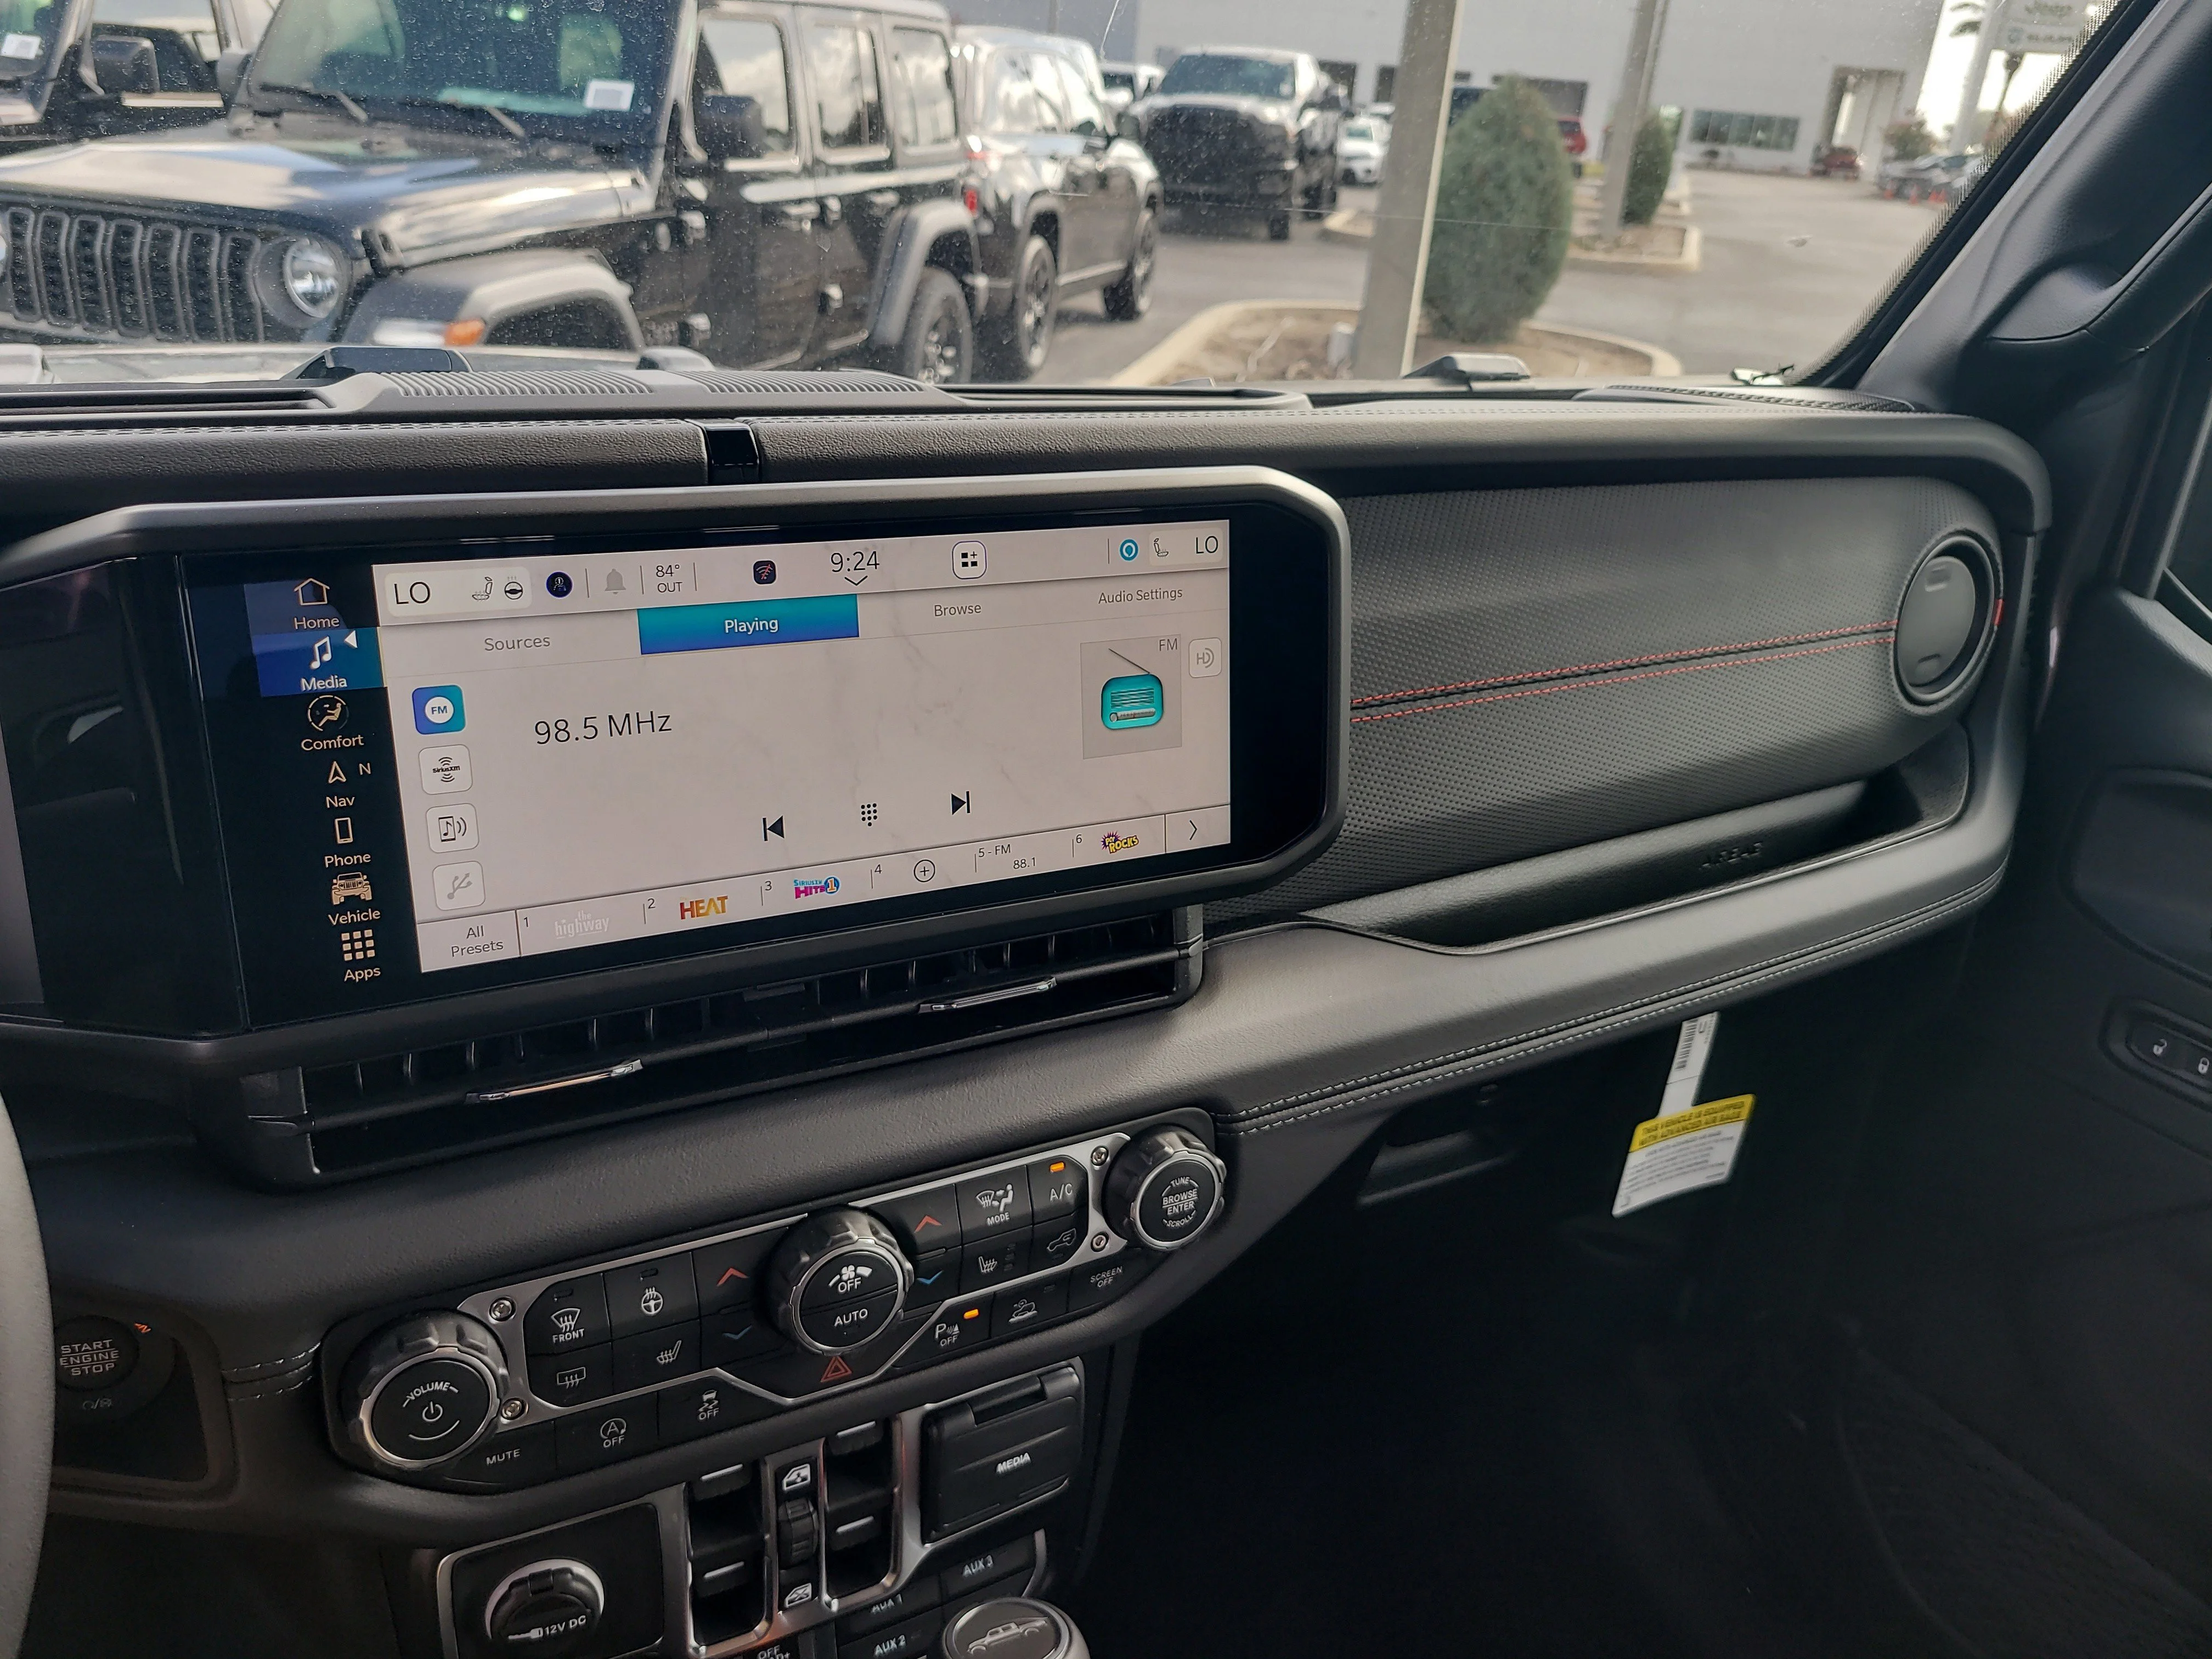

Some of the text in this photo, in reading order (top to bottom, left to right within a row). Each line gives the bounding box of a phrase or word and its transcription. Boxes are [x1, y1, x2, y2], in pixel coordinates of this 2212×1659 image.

[1195, 535, 1218, 555] LO
[830, 550, 880, 573] 9:24
[656, 564, 680, 578] 84°
[394, 582, 431, 605] LO
[657, 582, 683, 593] OUT
[1098, 588, 1183, 605] Audio Settings
[934, 603, 981, 617] Browse
[294, 616, 340, 629] Home
[724, 617, 779, 634] Playing
[484, 635, 551, 652] Sources
[1159, 637, 1178, 652] FM
[301, 675, 347, 691] Media
[431, 706, 448, 714] FM
[534, 710, 672, 745] 98.5 MHz
[301, 735, 364, 751] Comfort
[359, 763, 371, 775] N
[326, 795, 355, 809] Nav
[1075, 833, 1082, 844] 6
[1109, 835, 1139, 854] ROCKS
[978, 847, 985, 858] 5
[994, 844, 1012, 856] FM
[324, 852, 371, 868] Phone
[1013, 856, 1036, 870] 88.1
[874, 864, 882, 874] 4
[764, 881, 772, 891] 3
[647, 898, 656, 909] 2
[680, 895, 729, 919] HEAT
[328, 909, 381, 926] Vehicle
[523, 917, 529, 928] 1
[578, 910, 591, 921] the
[466, 925, 484, 938] All
[555, 917, 610, 937] highway
[451, 940, 504, 957] Presets
[344, 967, 381, 983] Apps
[1171, 1176, 1190, 1187] TUNE
[1049, 1182, 1073, 1203] A/C
[1163, 1188, 1197, 1205] BROWSE
[1167, 1201, 1195, 1215] ENTER
[986, 1211, 1010, 1226] MODE
[1167, 1215, 1193, 1227] SCROLL
[1090, 1266, 1122, 1284] SCREEN
[1097, 1276, 1114, 1288] OFF
[838, 1277, 862, 1293] OFF
[833, 1308, 868, 1328] AUTO
[552, 1328, 584, 1344] FRONT
[940, 1334, 958, 1347] OFF
[60, 1339, 112, 1353] START
[59, 1350, 120, 1366] ENGINE
[71, 1362, 115, 1376] STOP
[407, 1381, 450, 1402] VOLUME
[698, 1408, 719, 1421] OFF
[603, 1435, 625, 1448] OFF
[486, 1448, 521, 1466] MUTE
[996, 1453, 1031, 1474] MEDIA
[962, 1555, 994, 1577] AUX 3
[545, 1615, 586, 1635] 12V DC
[874, 1634, 906, 1656] AUX 2
